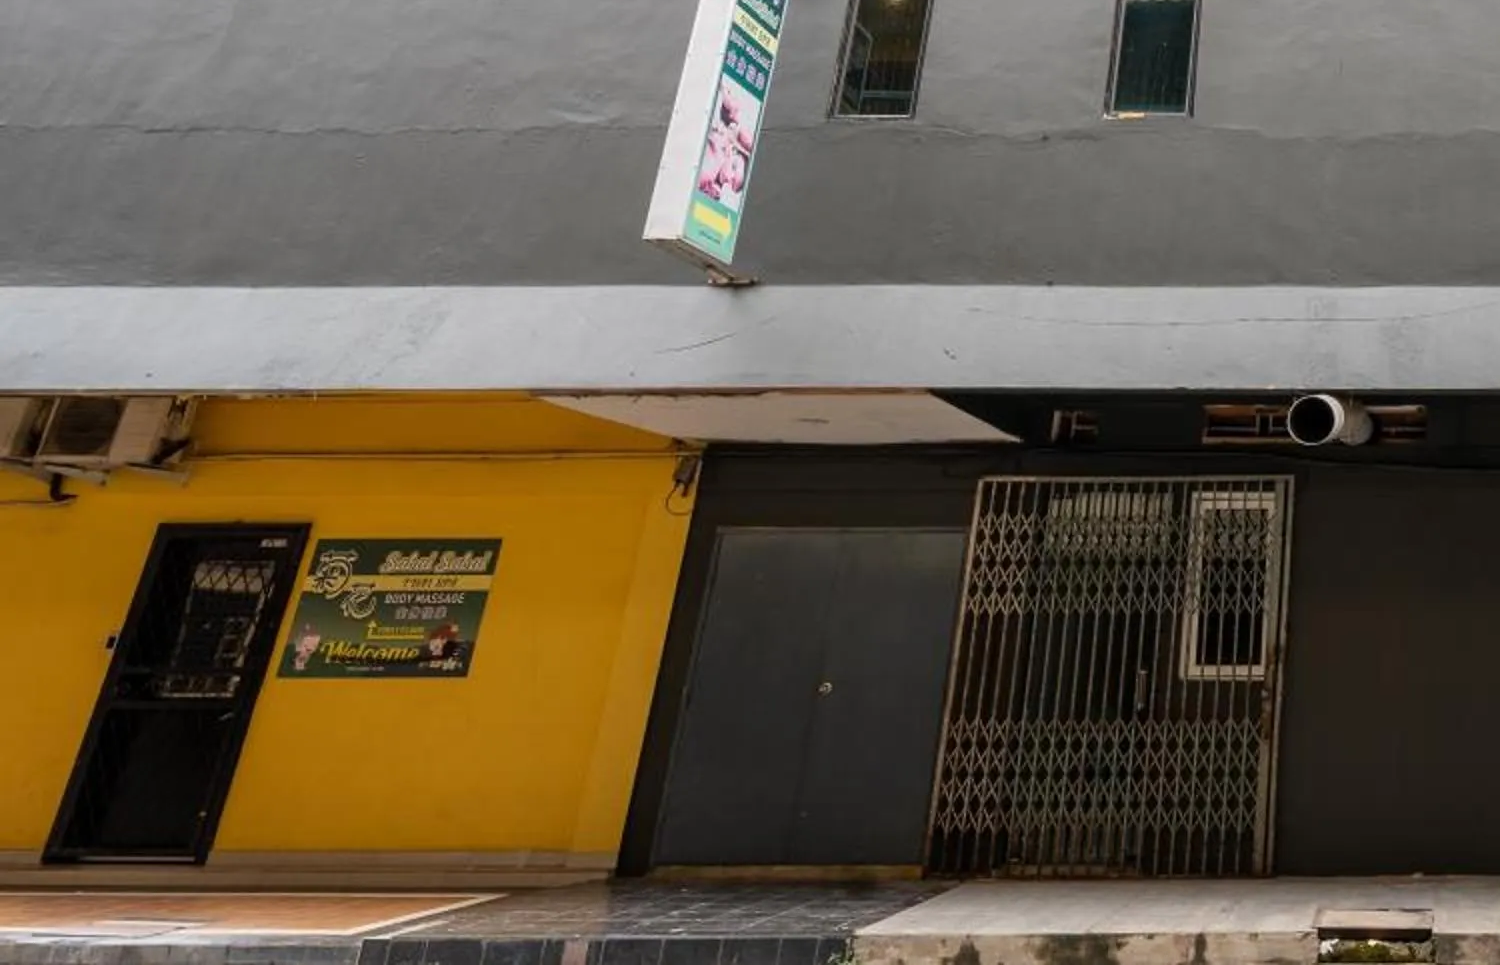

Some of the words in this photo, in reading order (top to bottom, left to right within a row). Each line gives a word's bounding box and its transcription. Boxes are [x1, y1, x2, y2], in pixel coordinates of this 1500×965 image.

[384, 592, 416, 604] BODY
[415, 592, 465, 604] MASSAGE
[320, 639, 420, 664] Welcome
